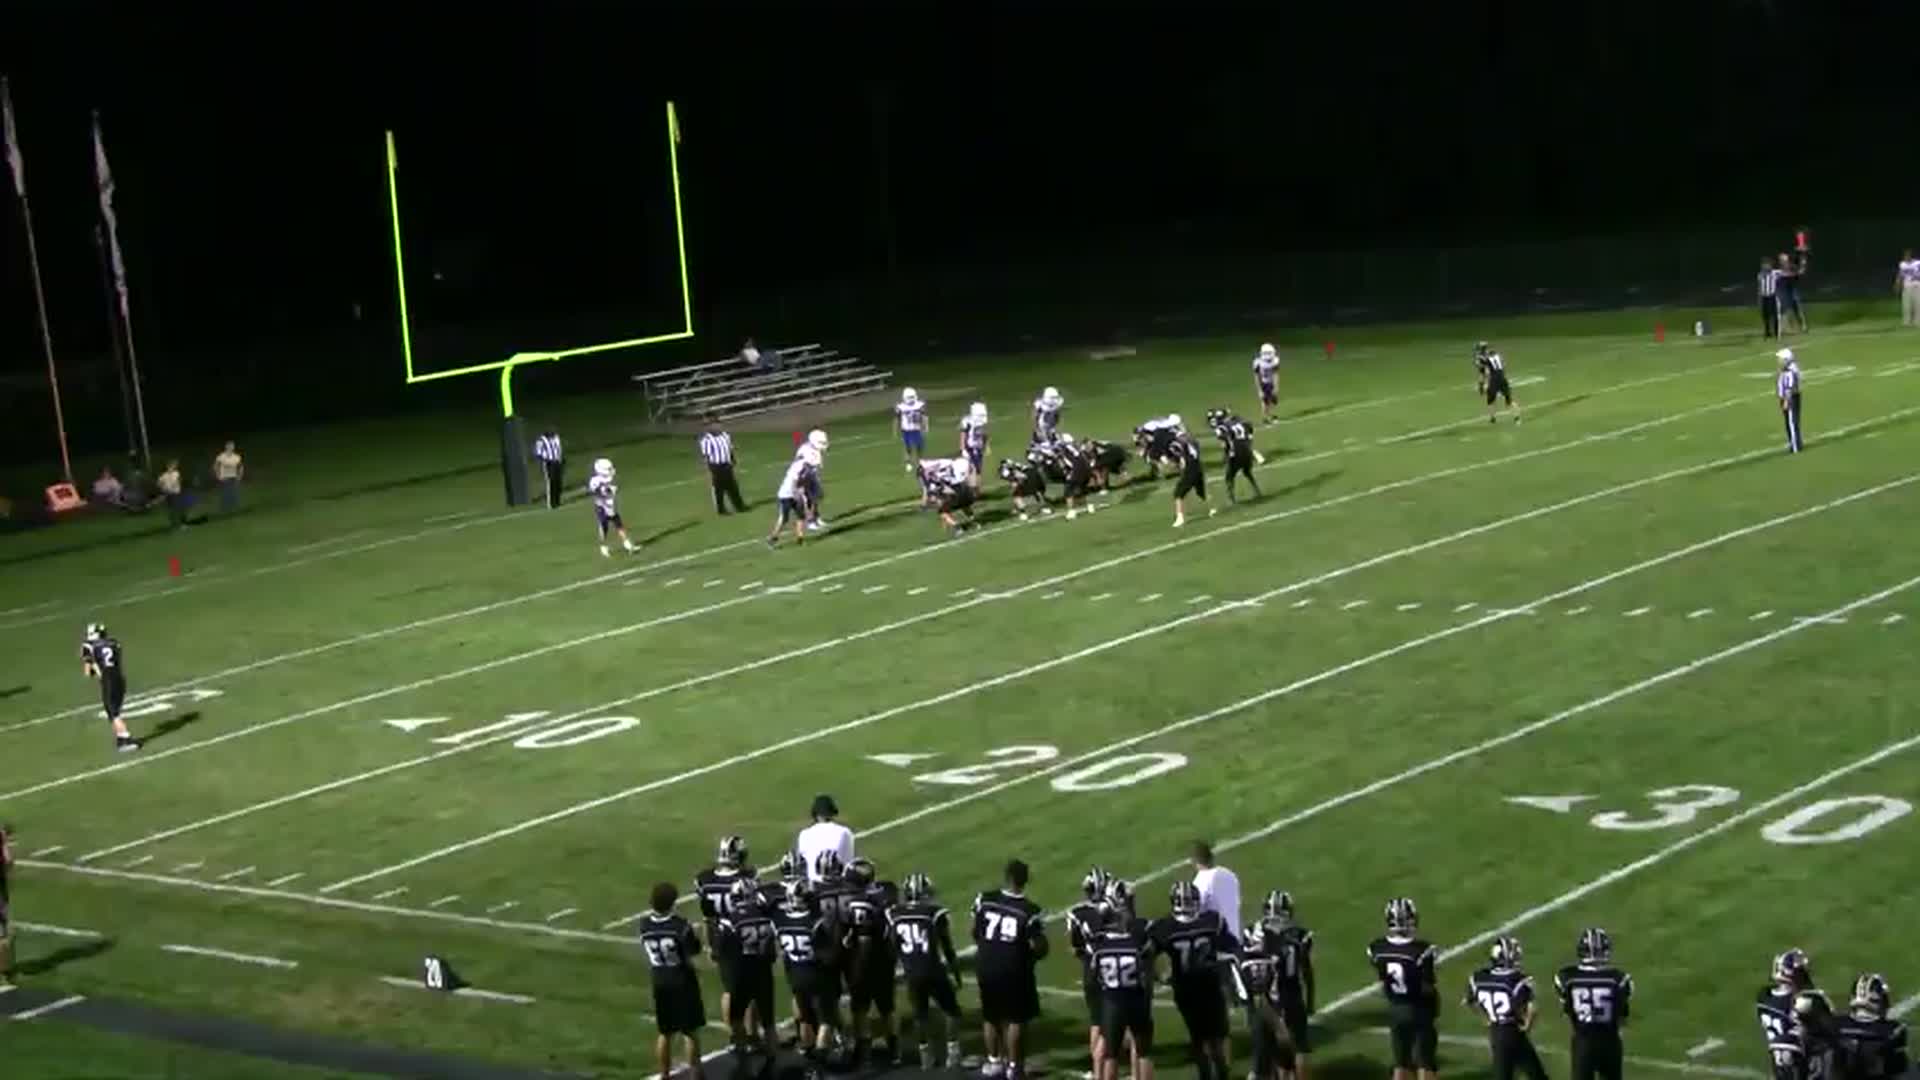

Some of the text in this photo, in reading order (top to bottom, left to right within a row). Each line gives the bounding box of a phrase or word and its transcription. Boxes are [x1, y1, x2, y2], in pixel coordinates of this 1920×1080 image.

[101, 647, 115, 667] 2
[427, 710, 641, 748] 10
[911, 745, 1188, 791] 20
[1589, 784, 1913, 844] 30
[780, 934, 814, 961] 25
[896, 923, 929, 953] 34
[1386, 961, 1408, 994] 3
